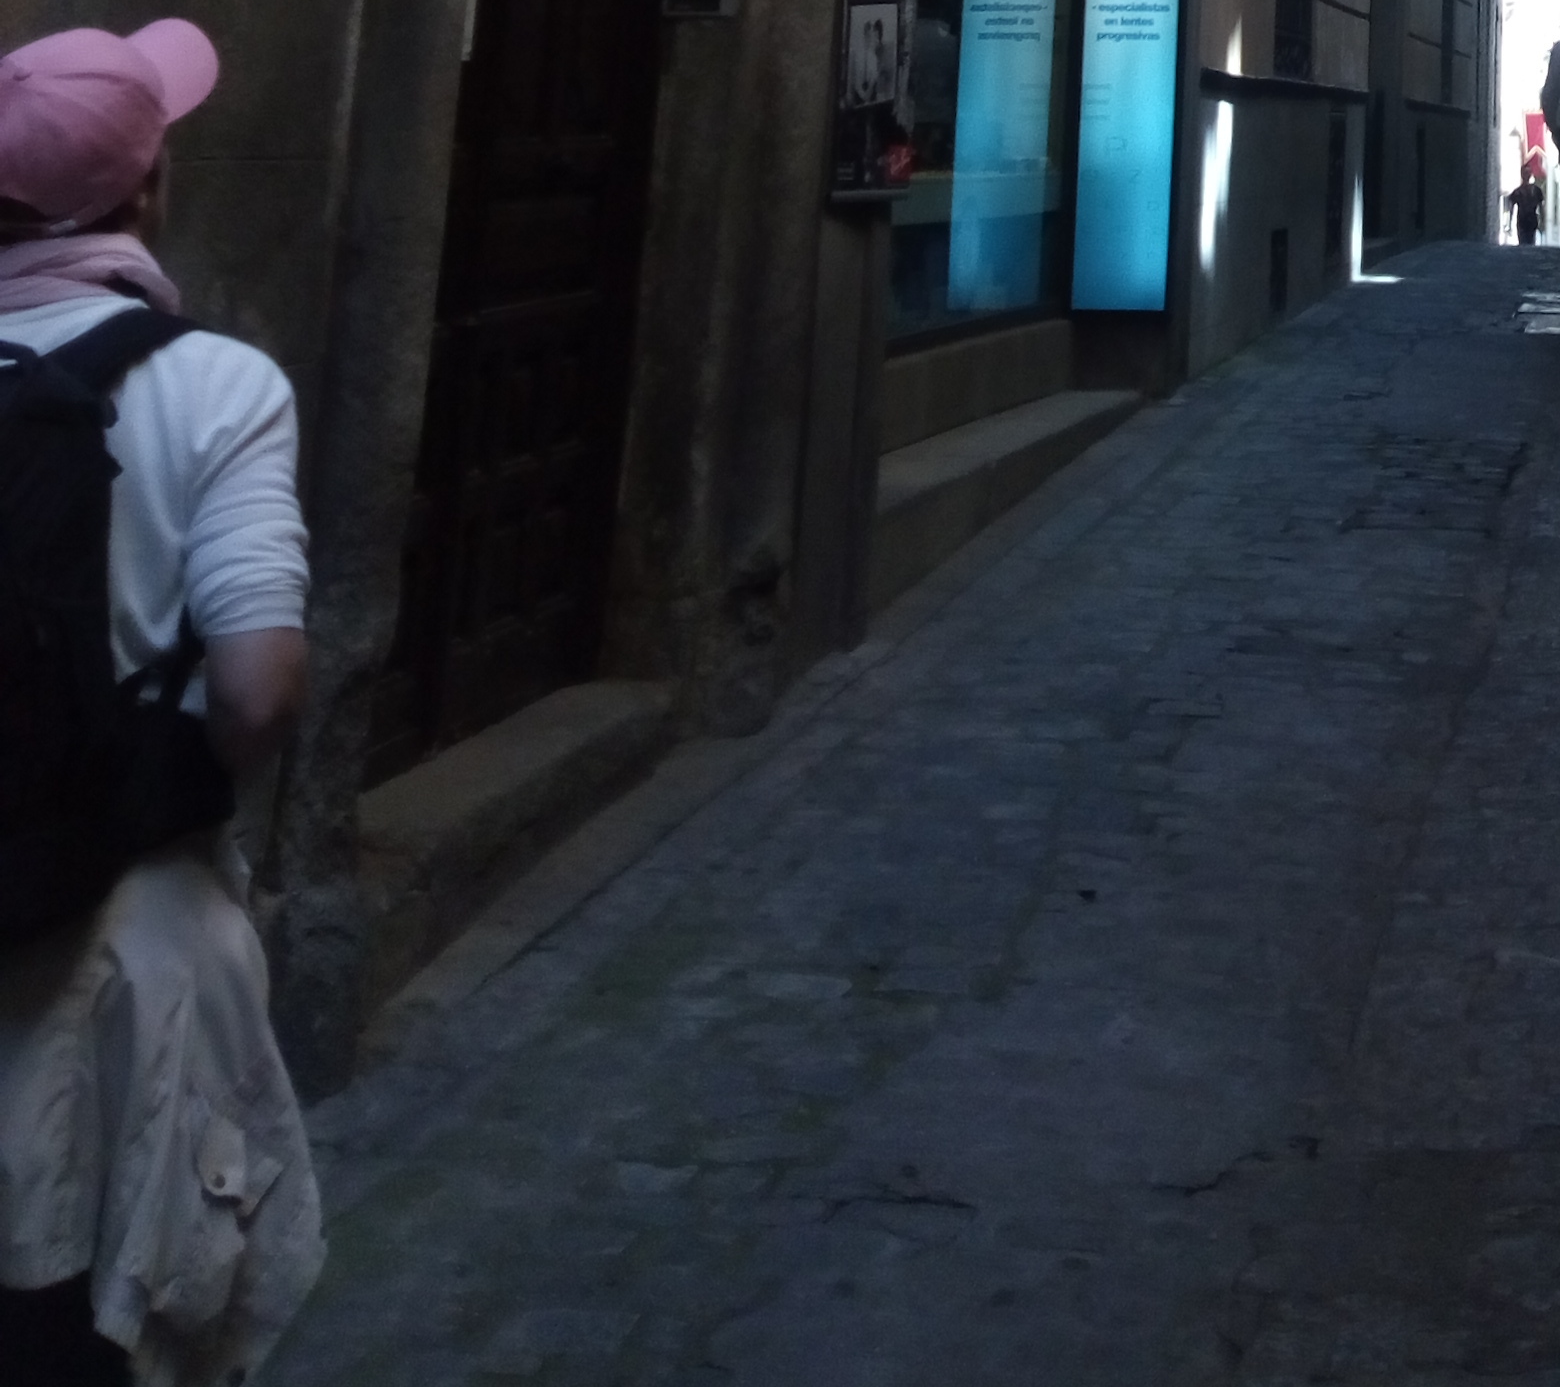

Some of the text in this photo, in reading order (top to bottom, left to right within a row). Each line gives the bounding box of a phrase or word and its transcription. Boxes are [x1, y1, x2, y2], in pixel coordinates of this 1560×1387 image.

[1098, 4, 1170, 13] especialistas
[1104, 16, 1154, 26] en lentes
[1096, 30, 1161, 42] progresivas
